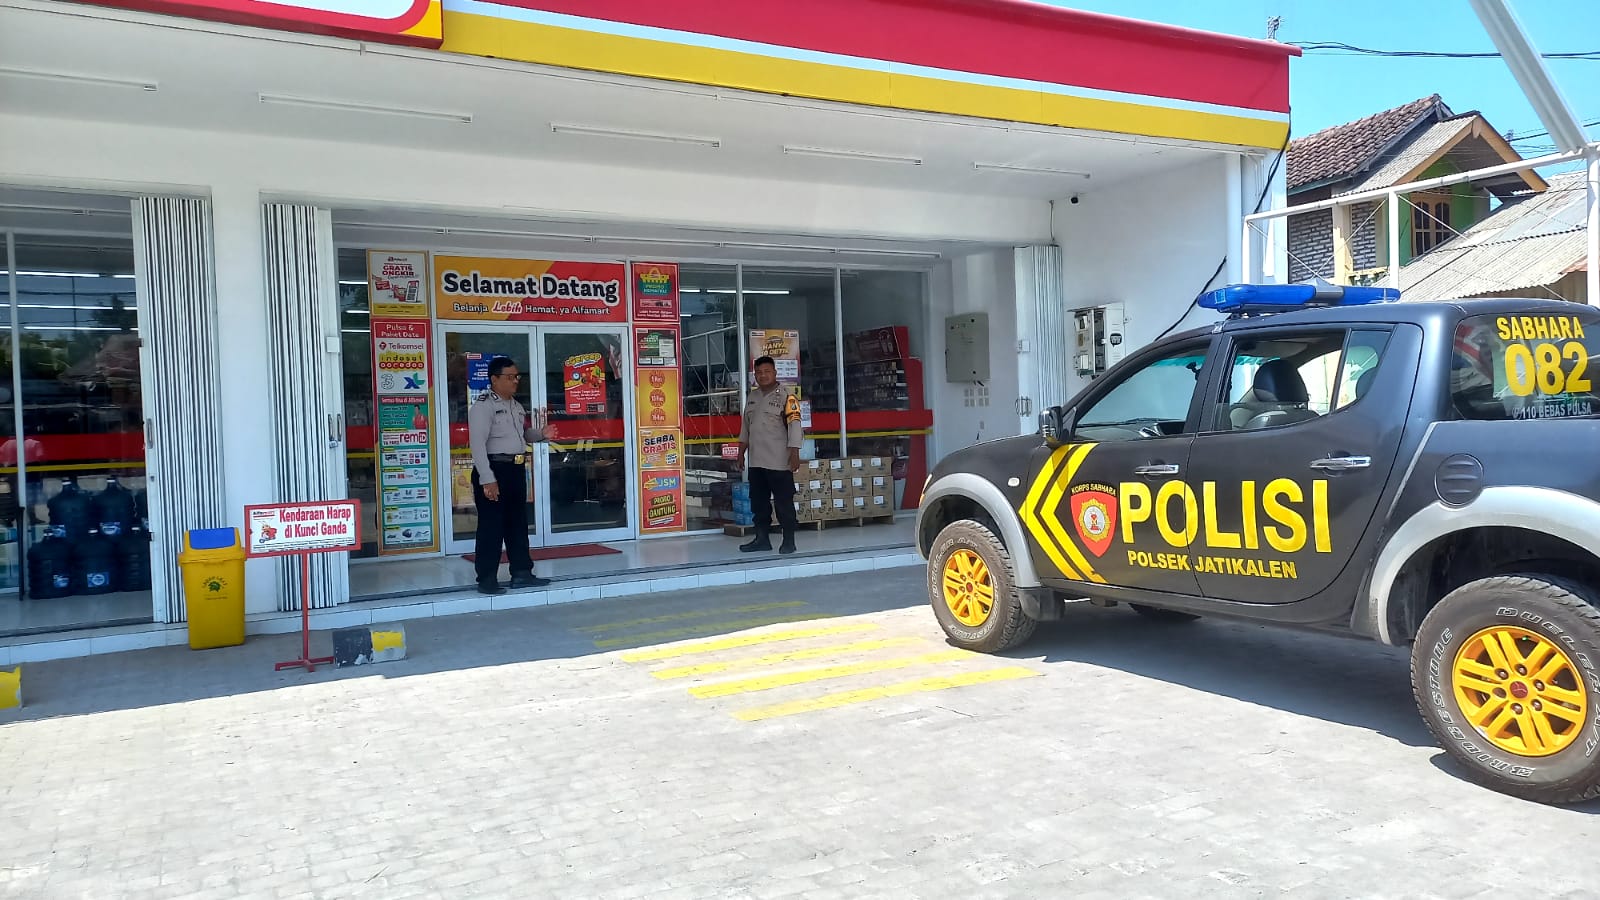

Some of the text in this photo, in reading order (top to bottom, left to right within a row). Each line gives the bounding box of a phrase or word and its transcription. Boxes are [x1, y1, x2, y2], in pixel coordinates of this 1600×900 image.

[443, 272, 618, 303] Selamat Datang
[453, 301, 610, 316] Belanja Lebih Hemat, ya Alfamart
[386, 323, 407, 331] Pulsa
[1497, 316, 1585, 340] SABHARA
[388, 342, 424, 350] Telkomsel
[1504, 341, 1592, 397] 082
[1521, 401, 1592, 419] 110 BEBAS PULSA
[643, 442, 677, 453] GRATIS
[644, 434, 675, 445] SERBA
[659, 478, 677, 487] JSM
[1071, 483, 1116, 496] KORPS SABHARA
[279, 506, 351, 523] Kendaraan Harap
[1119, 478, 1332, 553] POLISI
[284, 521, 347, 538] di Kunci Ganda
[1127, 550, 1298, 579] POLSEK JATIKALEN
[1427, 628, 1536, 778] BRIDGESTONE
